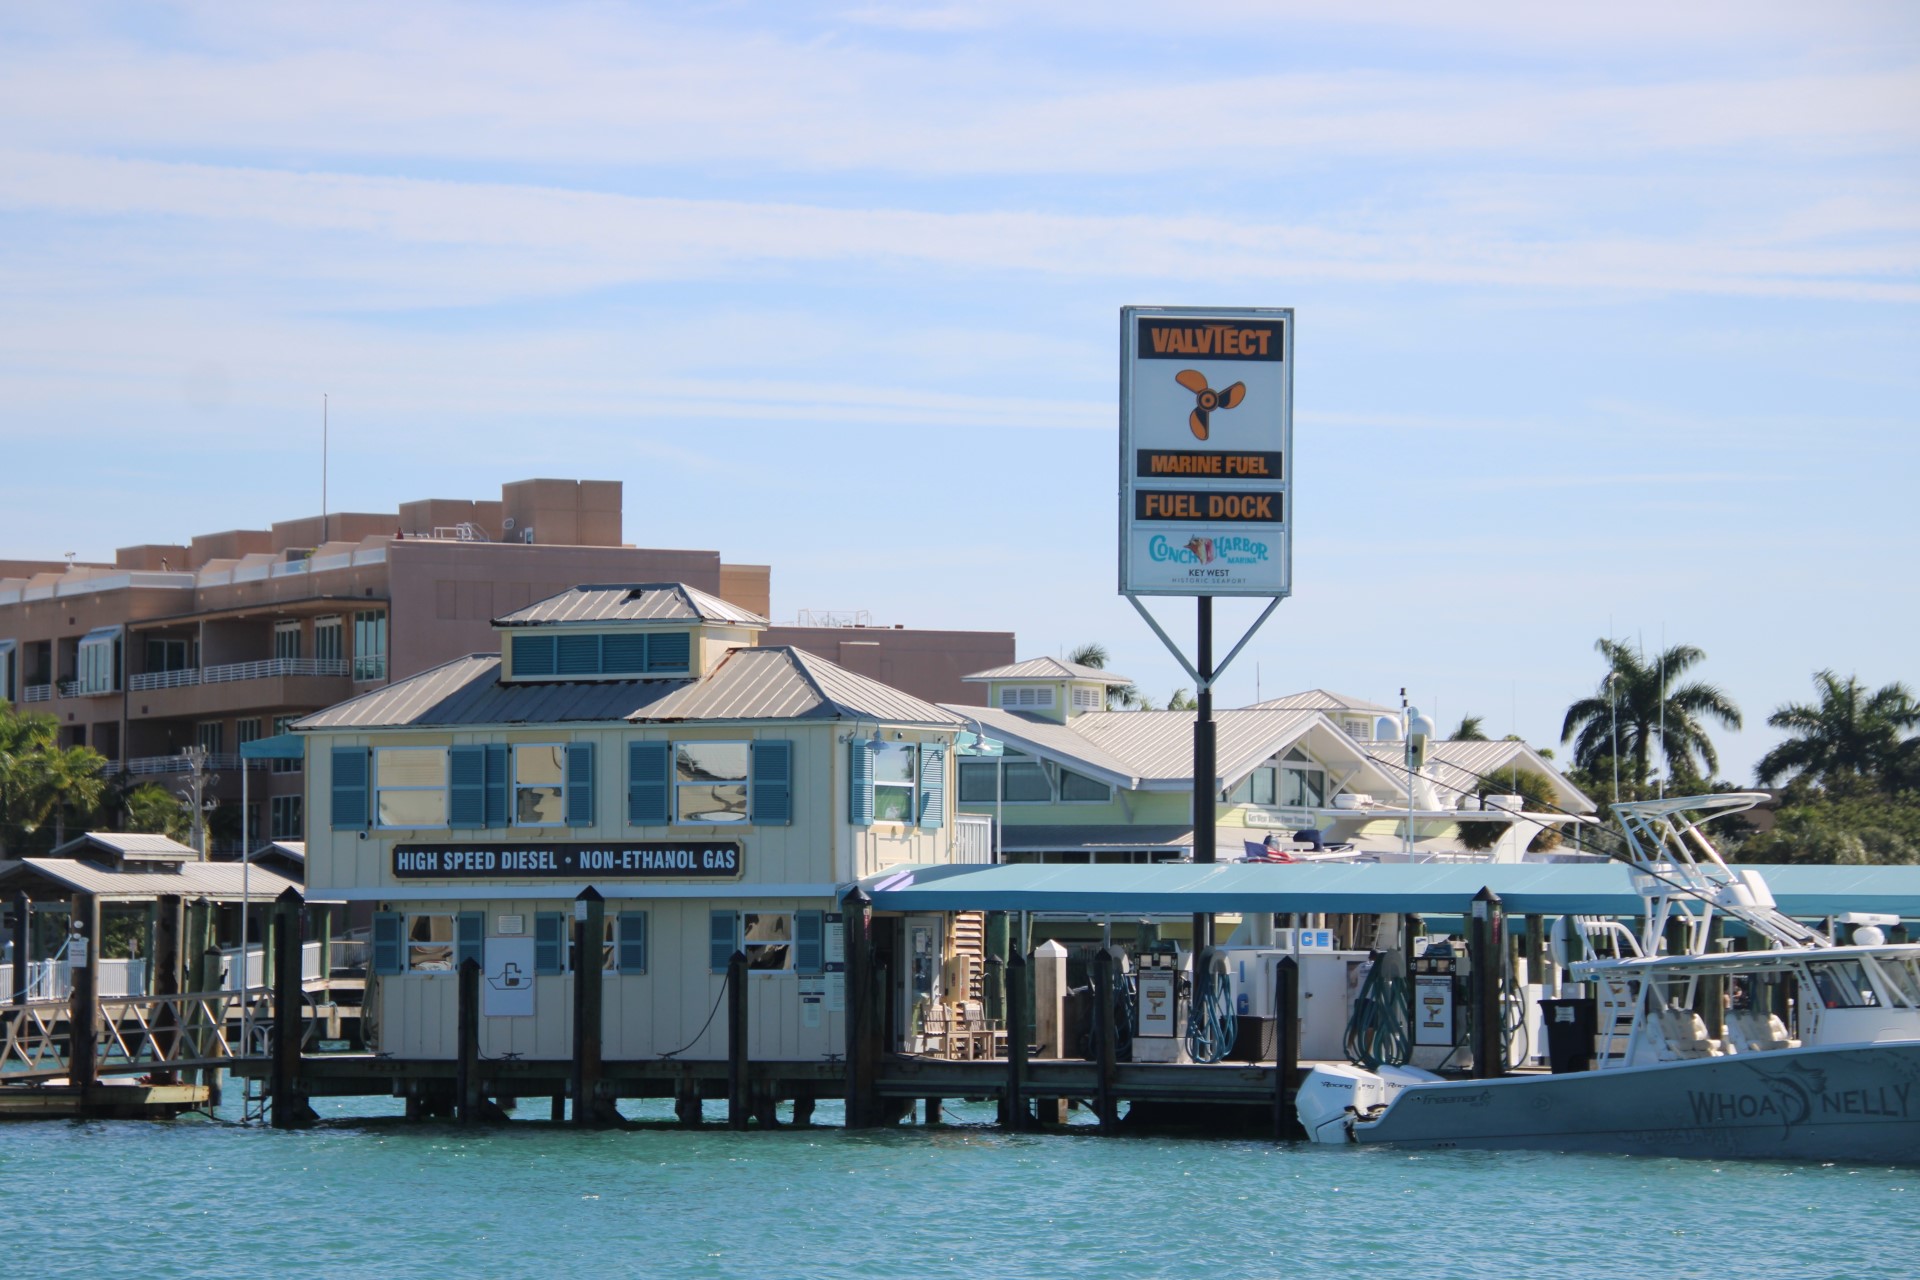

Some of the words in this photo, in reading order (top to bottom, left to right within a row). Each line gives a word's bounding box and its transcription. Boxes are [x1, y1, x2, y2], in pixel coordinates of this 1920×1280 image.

[1151, 325, 1271, 355] VALVTECT
[1151, 455, 1222, 474] MARINE
[1225, 456, 1269, 474] FUEL
[1145, 494, 1202, 517] FUEL
[1209, 495, 1273, 519] DOCK
[1213, 536, 1268, 561] HARBOR
[1188, 568, 1206, 577] KEY
[1207, 569, 1230, 577] WEST
[398, 852, 437, 870] HIGH
[443, 852, 495, 870] SPEED
[501, 851, 557, 869] DIESEL
[580, 850, 697, 869] NON-ETHANOL
[703, 850, 735, 868] GAS
[1688, 1090, 1777, 1125] WHOA
[1822, 1083, 1910, 1118] NELLY
